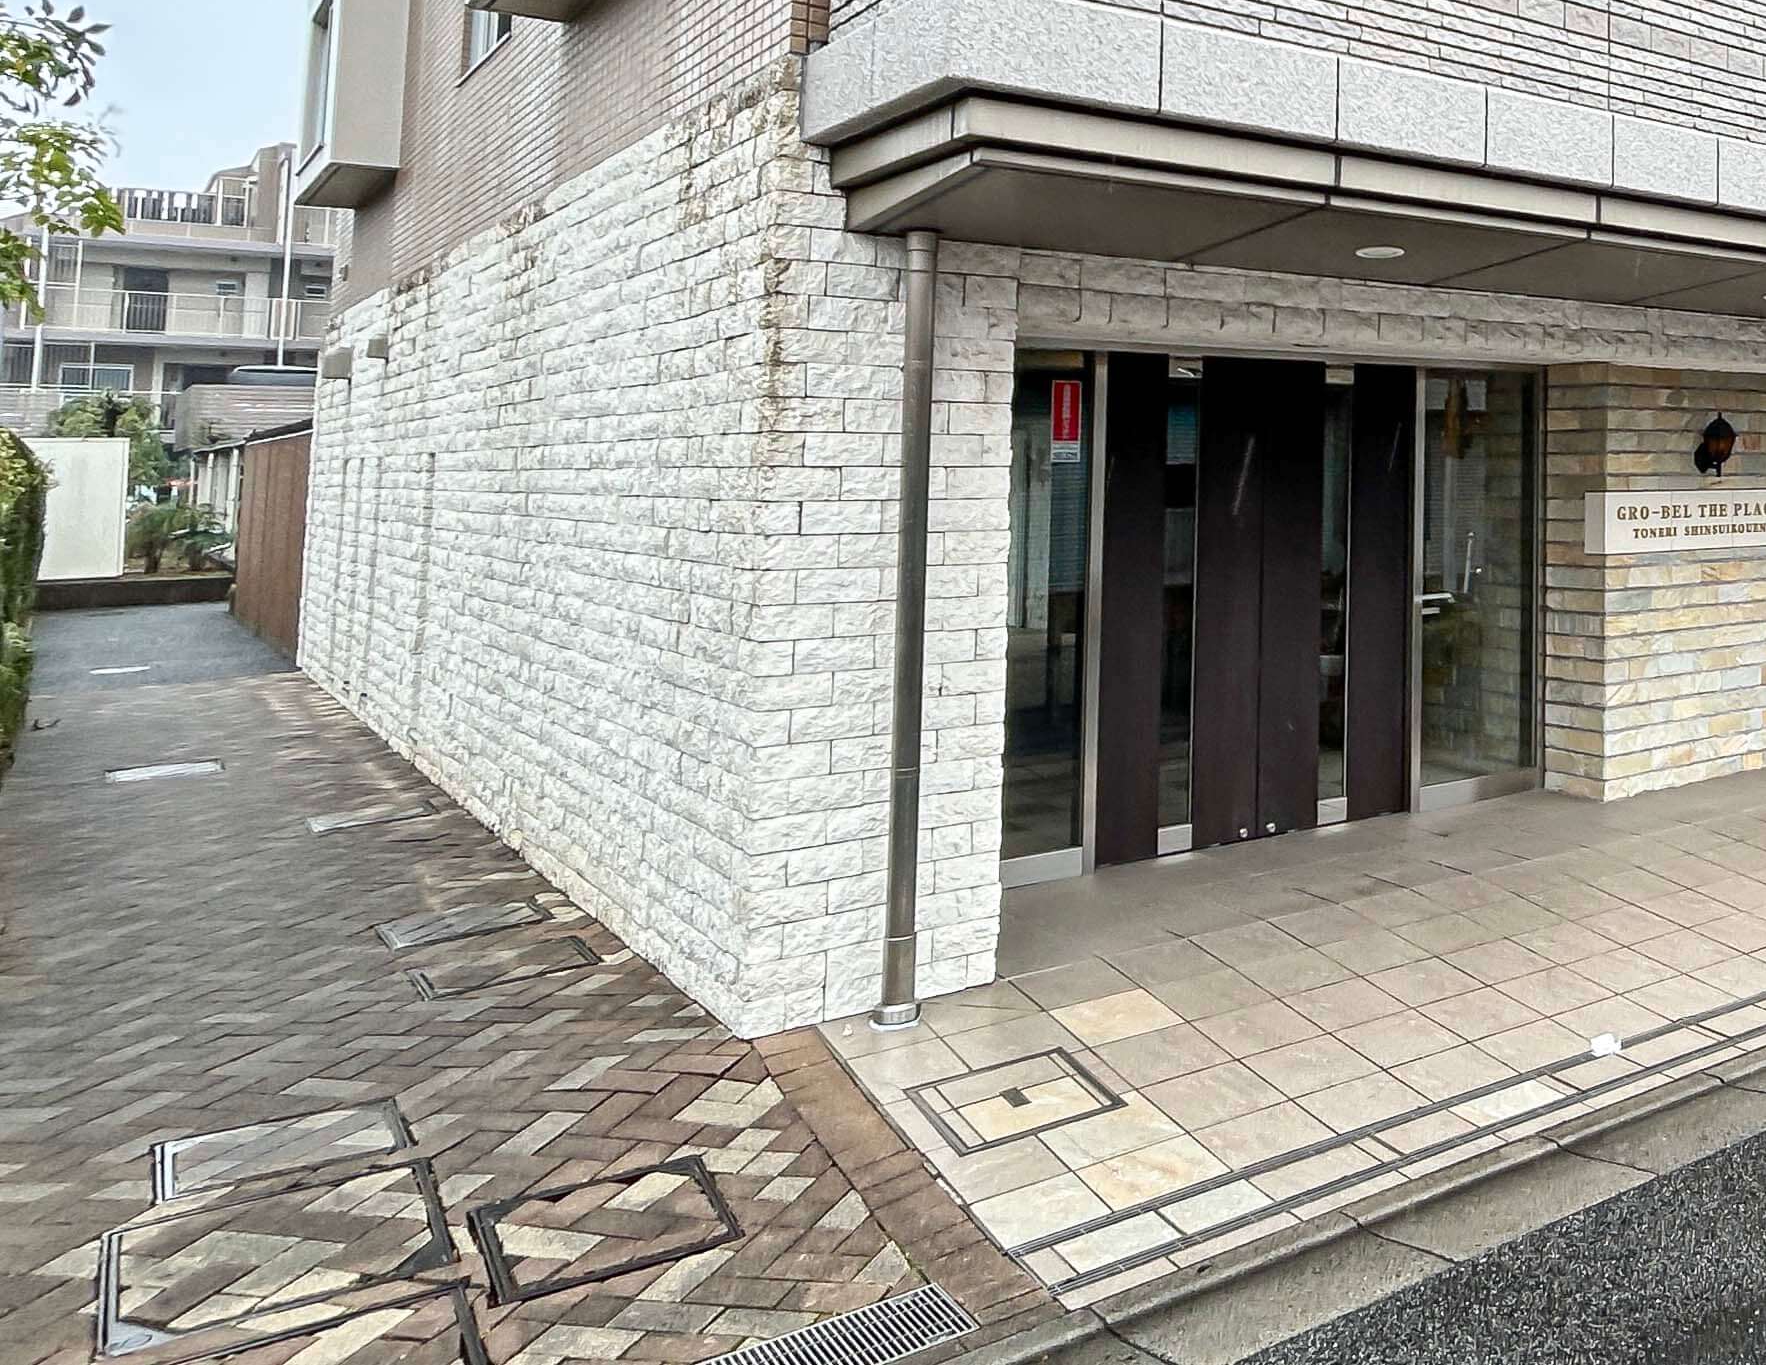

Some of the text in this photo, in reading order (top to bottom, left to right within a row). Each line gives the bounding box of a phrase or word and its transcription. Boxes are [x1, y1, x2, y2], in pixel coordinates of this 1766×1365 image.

[1616, 504, 1693, 521] GRO-BEL
[1698, 503, 1728, 518] THE
[1632, 523, 1766, 540] TONERI SHINSUIKOUEN
